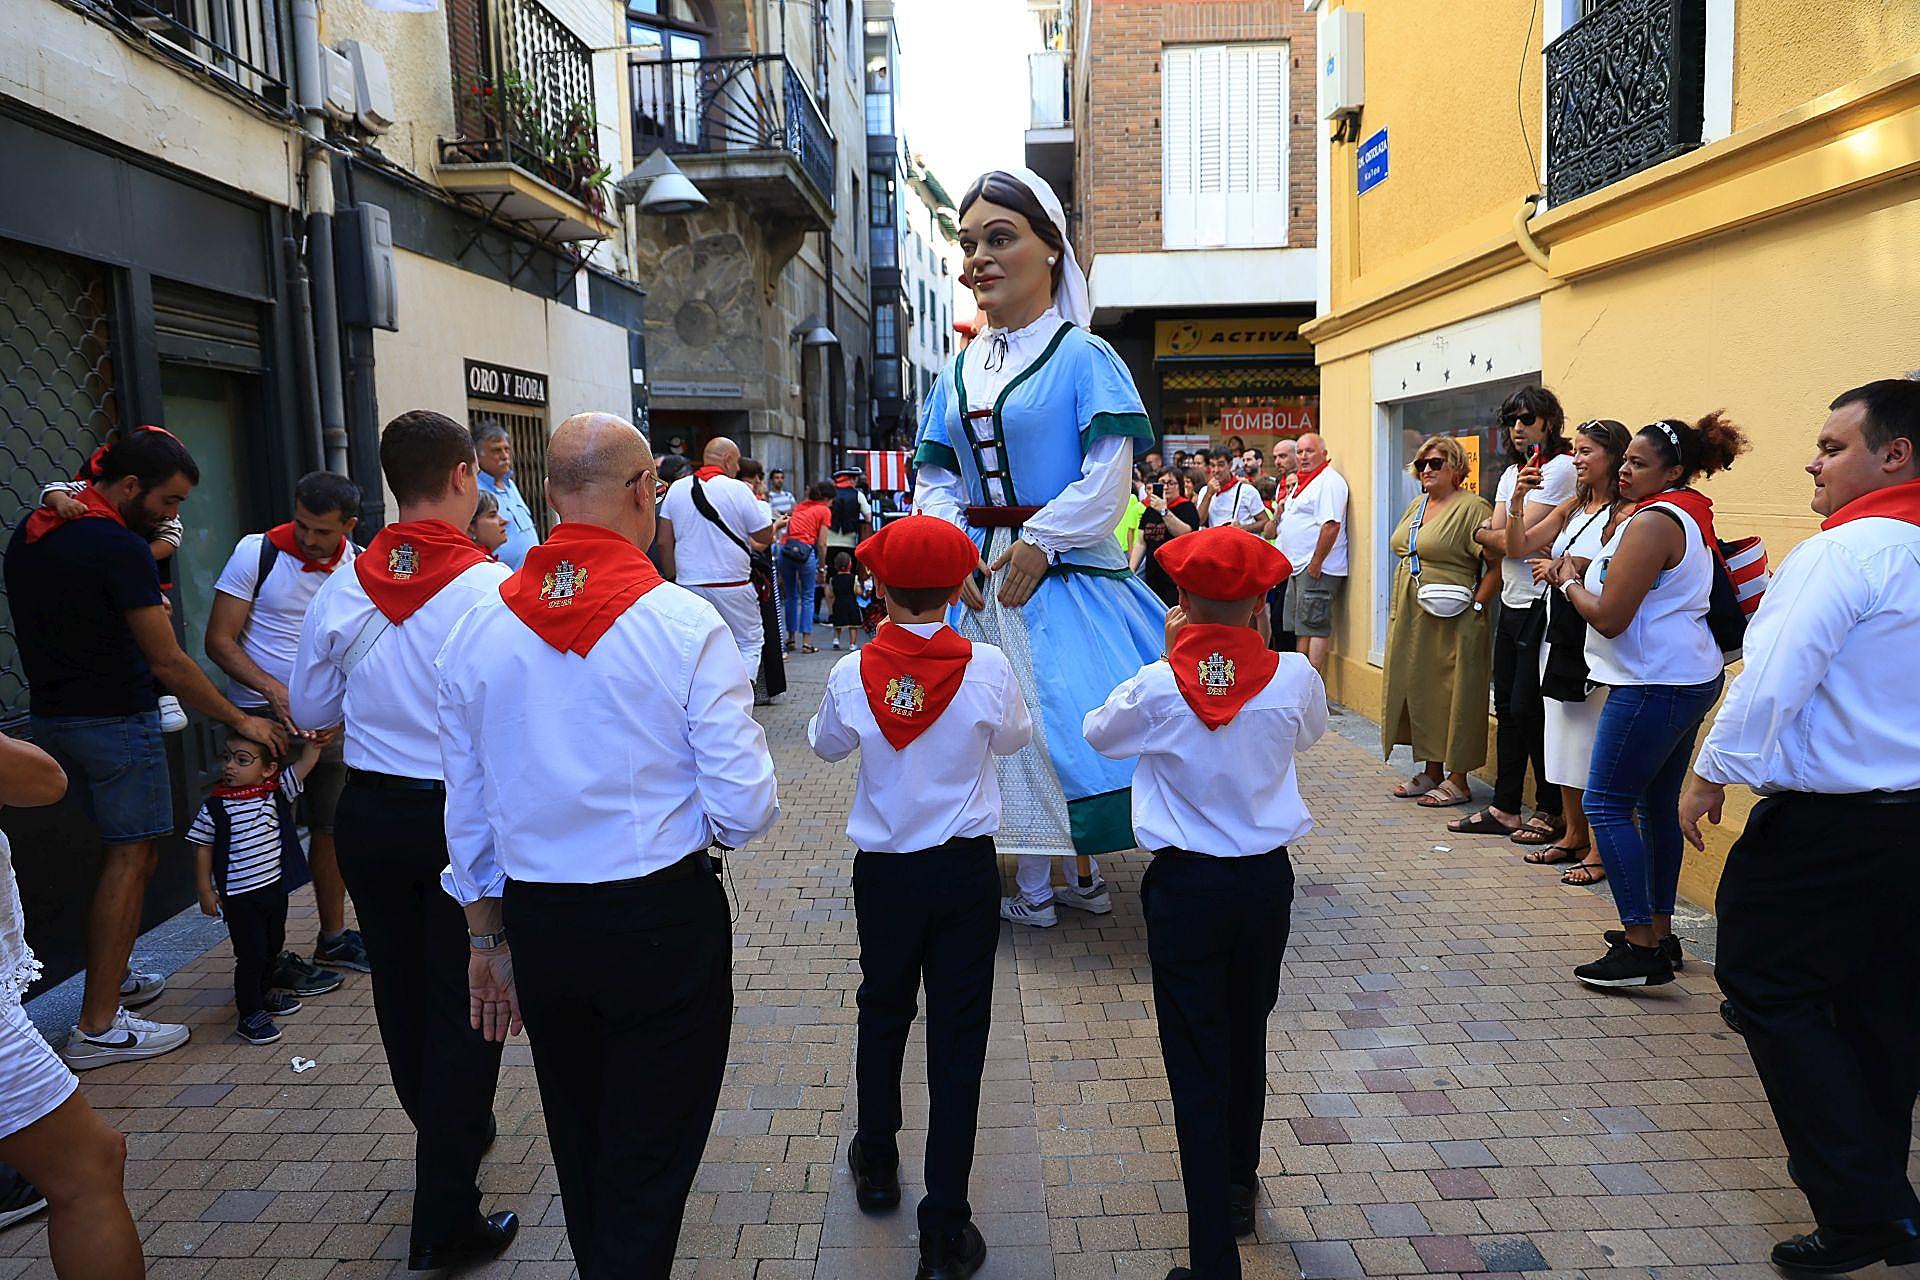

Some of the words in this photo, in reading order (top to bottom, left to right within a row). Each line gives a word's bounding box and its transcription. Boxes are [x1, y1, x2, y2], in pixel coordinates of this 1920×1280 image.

[1210, 331, 1299, 342] ACTIVA
[470, 366, 499, 394] ORO
[502, 372, 512, 396] Y
[514, 375, 546, 402] HORA
[1221, 409, 1313, 431] TÓMBOLA
[890, 706, 913, 718] DEBA
